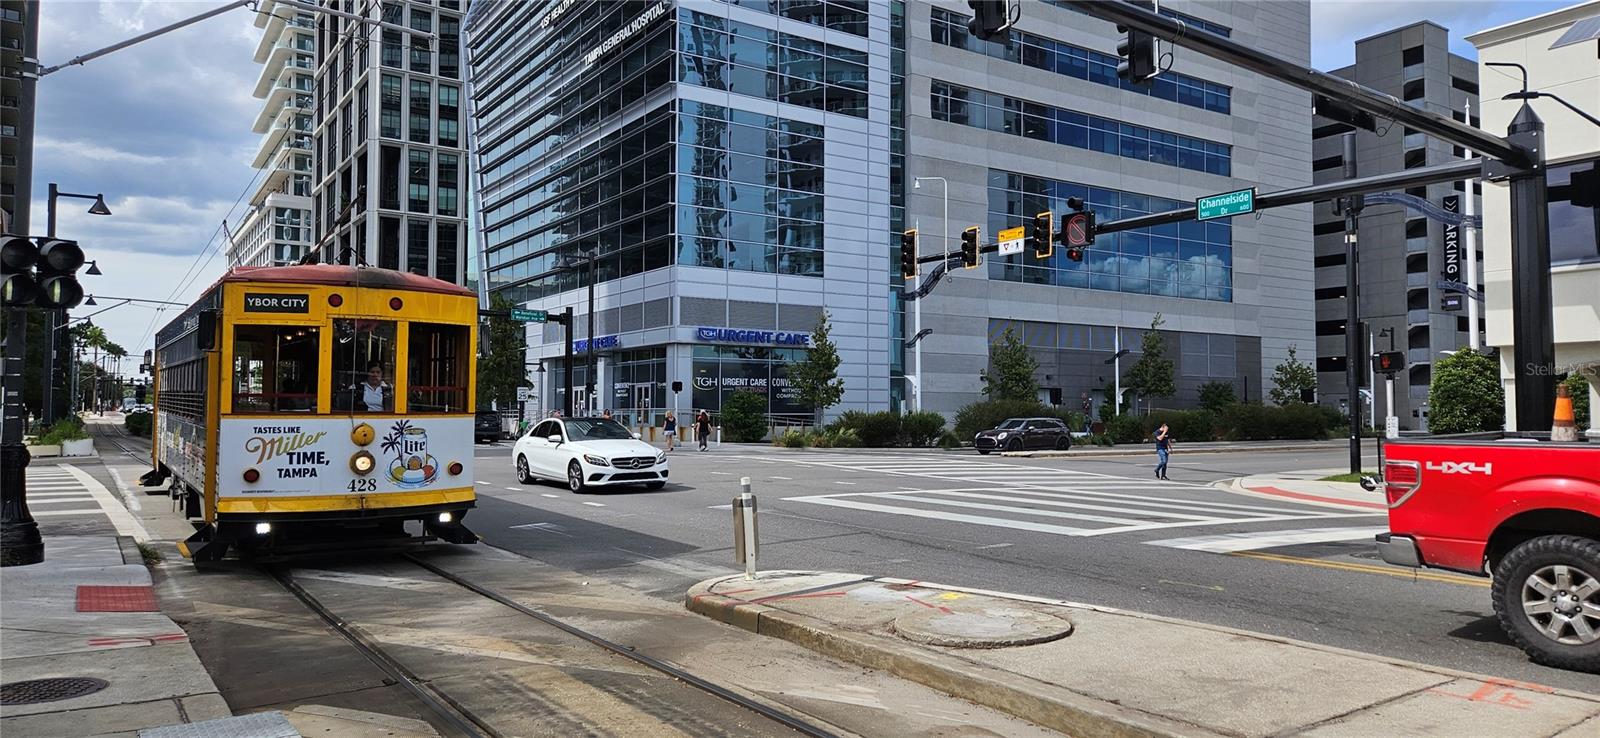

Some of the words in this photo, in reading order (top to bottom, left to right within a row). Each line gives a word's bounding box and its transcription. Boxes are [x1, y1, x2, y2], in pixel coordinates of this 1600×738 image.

[584, 41, 603, 66] TAMPA
[602, 25, 633, 53] GENERAL
[631, 1, 666, 33] HOSPITAL
[1200, 193, 1249, 209] Channelside
[1446, 223, 1458, 274] ARKING
[247, 298, 278, 307] YBOR
[281, 298, 307, 307] CITY
[719, 328, 773, 344] URGENT
[775, 332, 810, 345] CARE
[696, 376, 718, 387] TGH
[722, 377, 748, 386] URGENT
[750, 378, 767, 386] CARE
[253, 426, 282, 434] TASTES
[283, 426, 301, 434] LIKE
[245, 431, 328, 465] Miller
[404, 440, 426, 455] Lite
[287, 451, 331, 466] TIME,
[277, 467, 318, 479] TAMPA
[347, 478, 377, 492] 428
